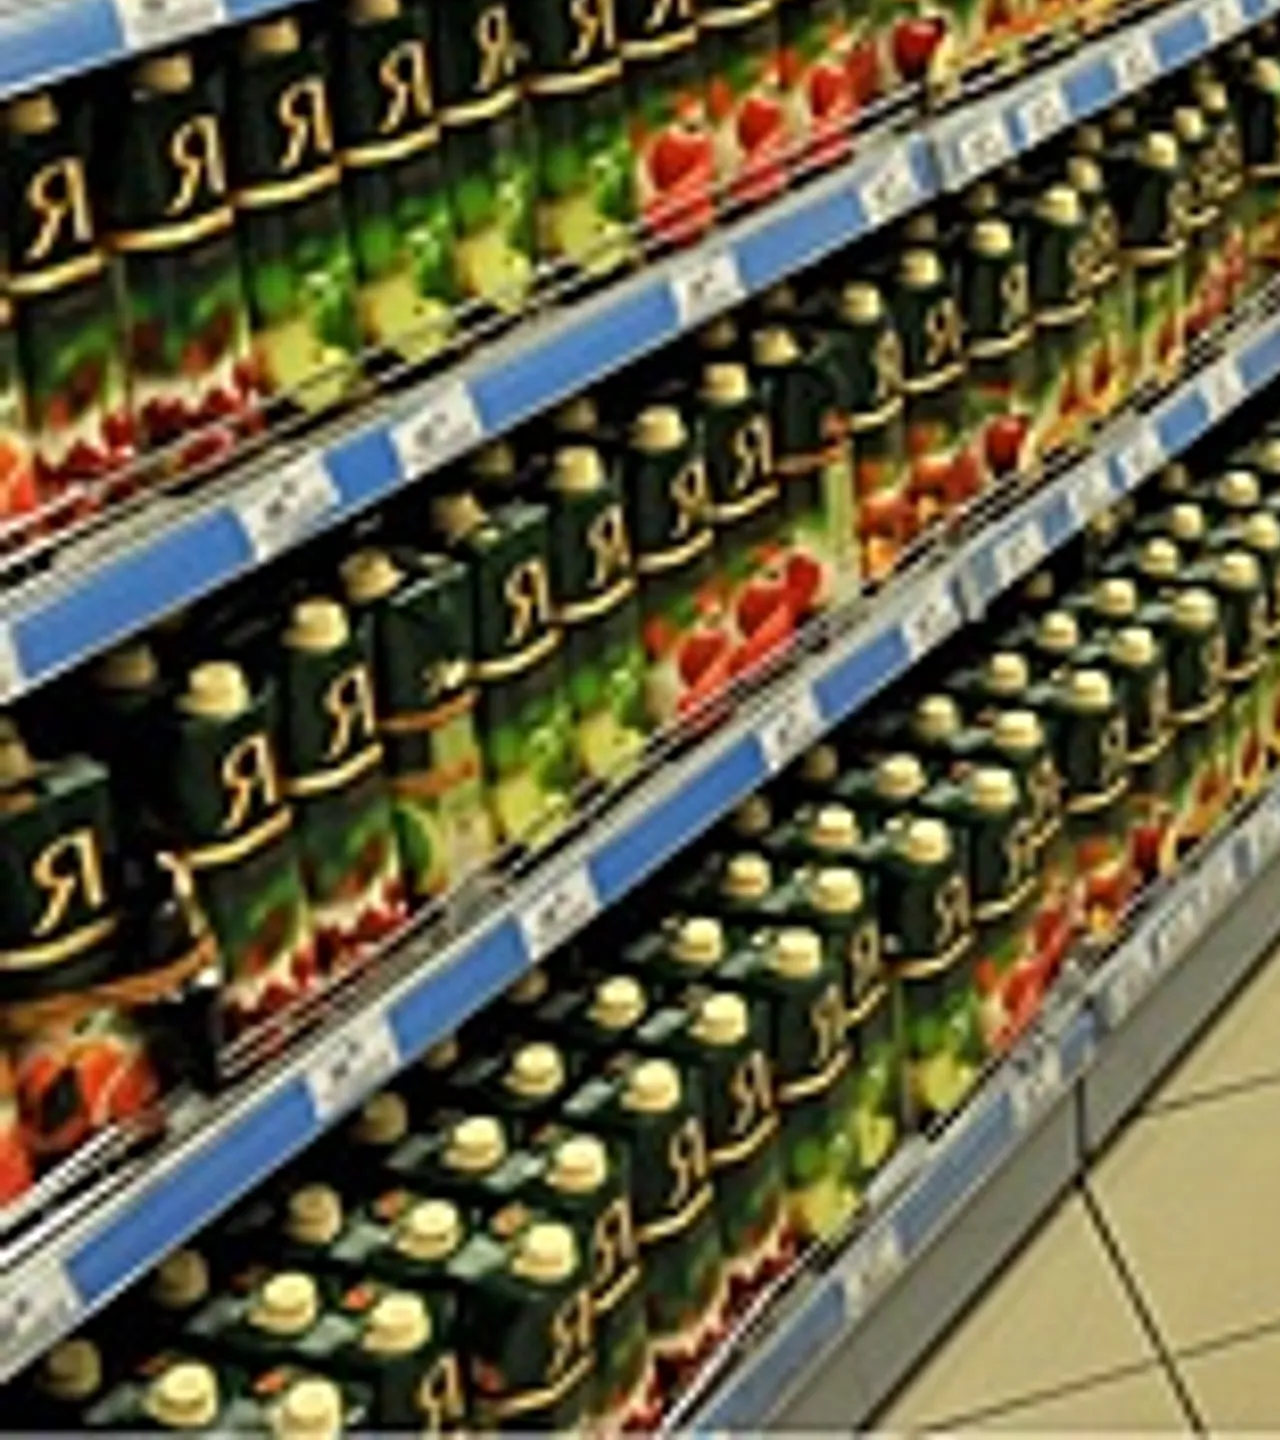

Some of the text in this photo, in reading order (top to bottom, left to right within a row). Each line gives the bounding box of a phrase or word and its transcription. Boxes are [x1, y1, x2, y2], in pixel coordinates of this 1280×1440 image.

[379, 40, 433, 134] Я
[473, 3, 516, 93] Я
[166, 114, 226, 216] Я
[278, 76, 334, 170] Я
[26, 158, 94, 261] Я
[926, 298, 963, 364] Я
[734, 415, 772, 491] Я
[671, 462, 711, 538] Я
[588, 505, 631, 588] Я
[505, 560, 553, 647] Я
[324, 664, 375, 760] Я
[223, 733, 279, 834] Я
[33, 830, 102, 937] Я
[937, 874, 972, 936] Я
[851, 920, 880, 1000] Я
[811, 983, 845, 1066] Я
[732, 1050, 773, 1135] Я
[670, 1118, 707, 1209] Я
[594, 1197, 638, 1285] Я
[549, 1289, 592, 1382] Я
[420, 1353, 465, 1433] Я
